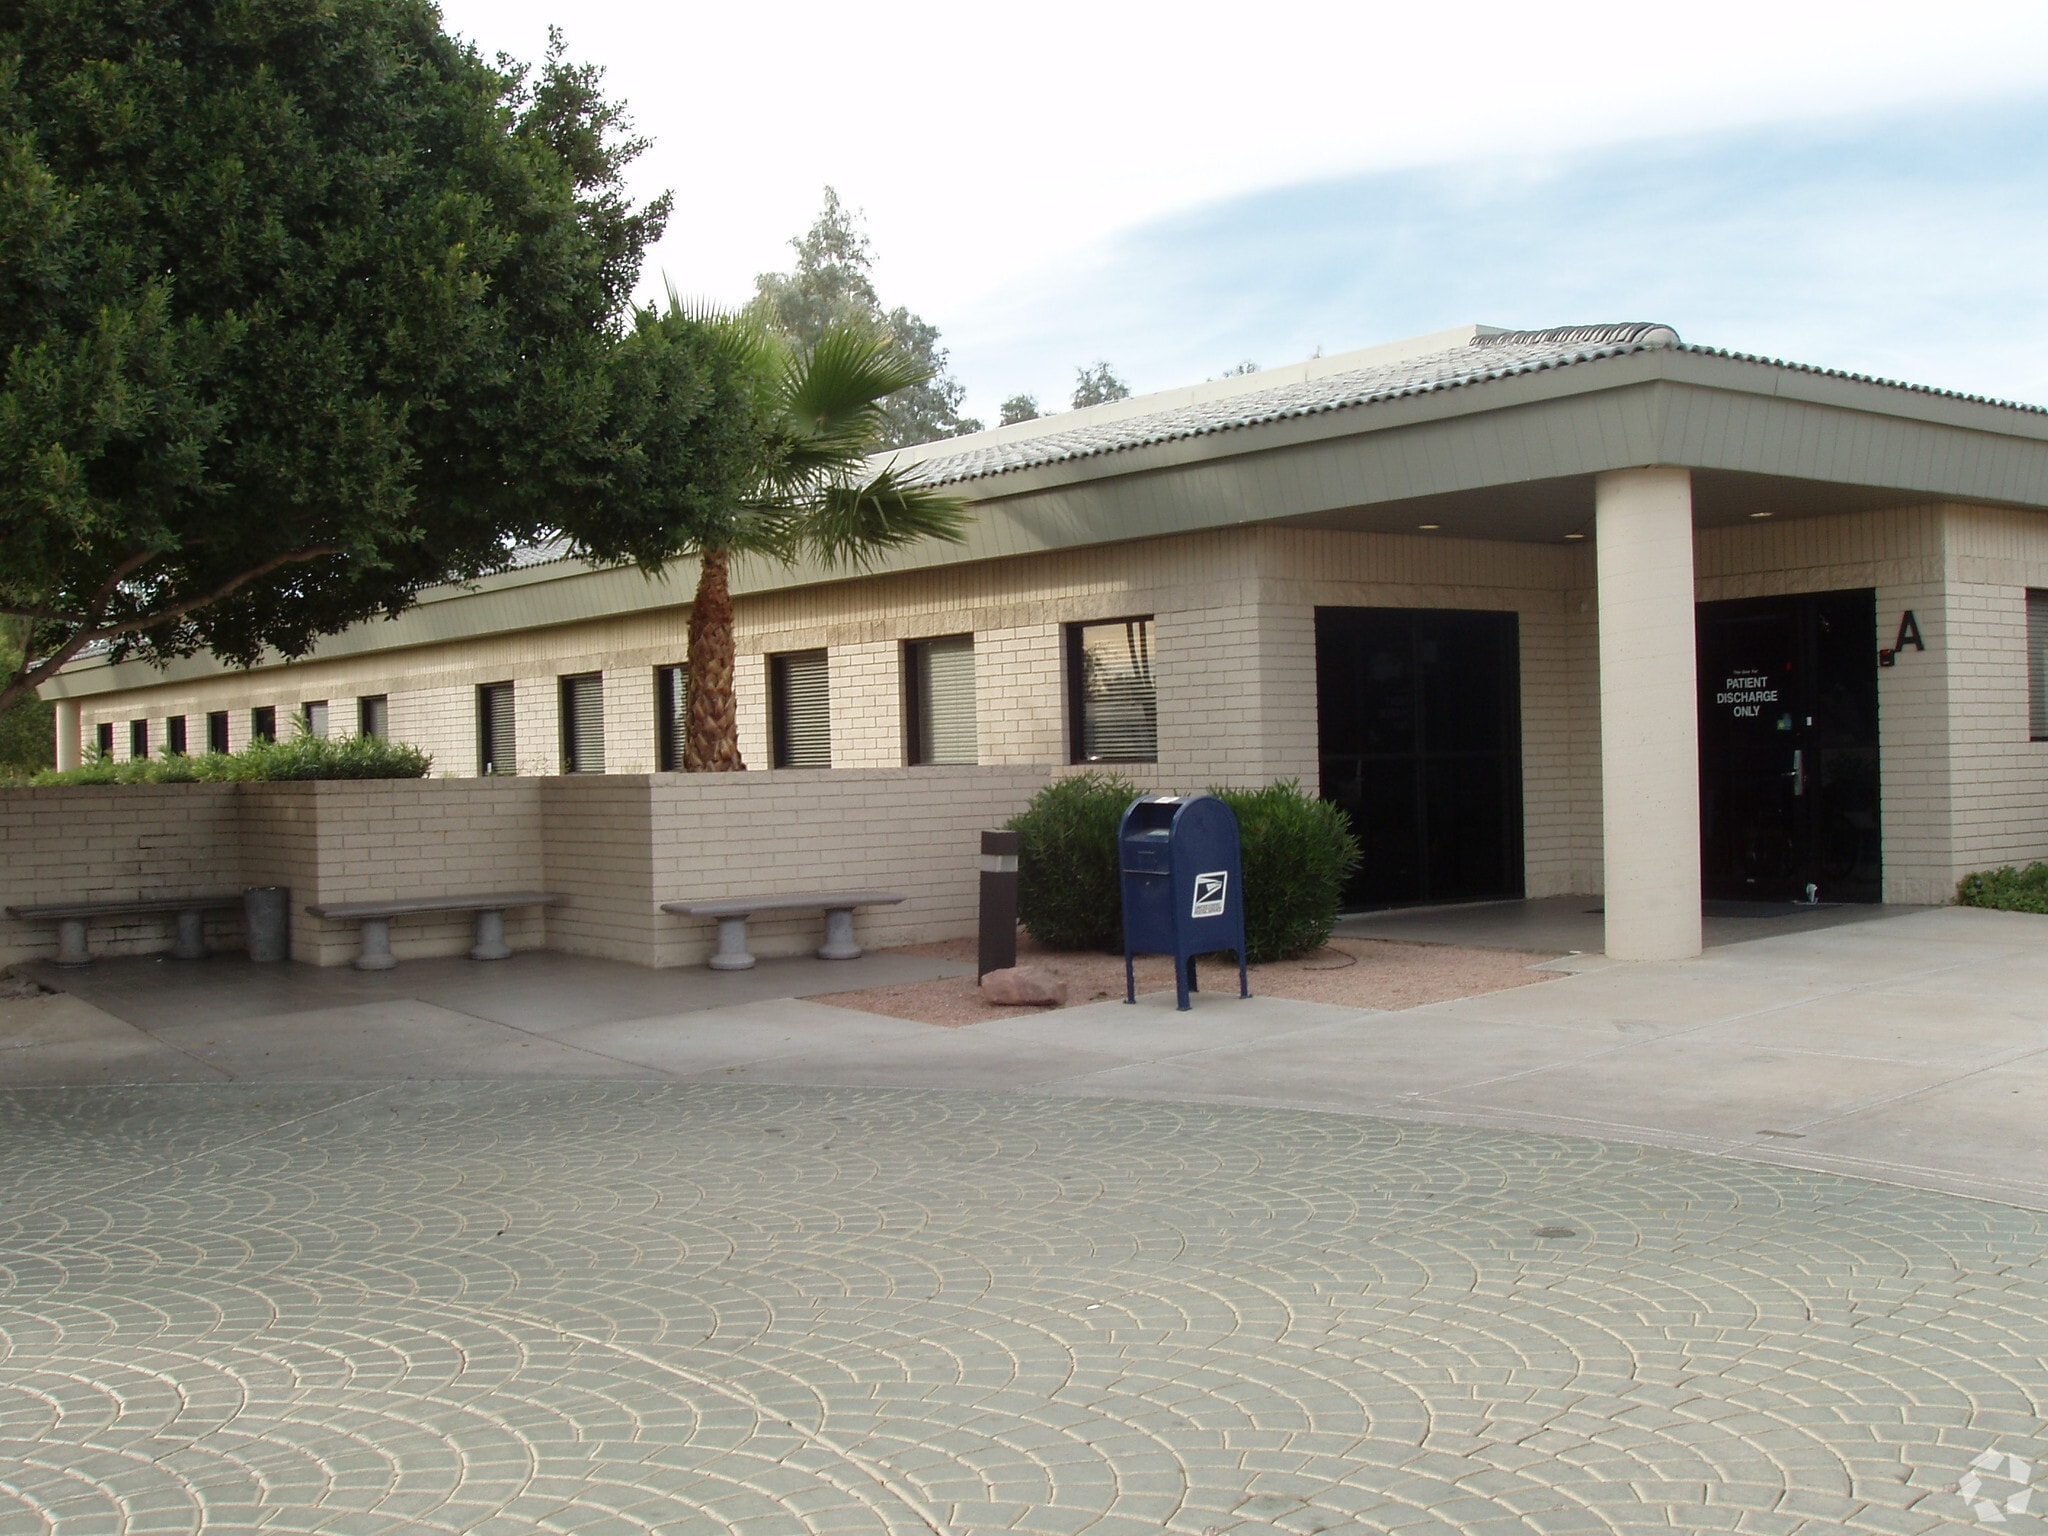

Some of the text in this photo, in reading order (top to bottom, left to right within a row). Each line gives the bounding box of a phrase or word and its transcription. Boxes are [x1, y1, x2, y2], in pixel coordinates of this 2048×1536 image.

[1895, 610, 1925, 652] A
[1726, 676, 1768, 690] PATIENT
[1716, 690, 1778, 704] DISCHARGE
[1733, 705, 1760, 717] ONLY
